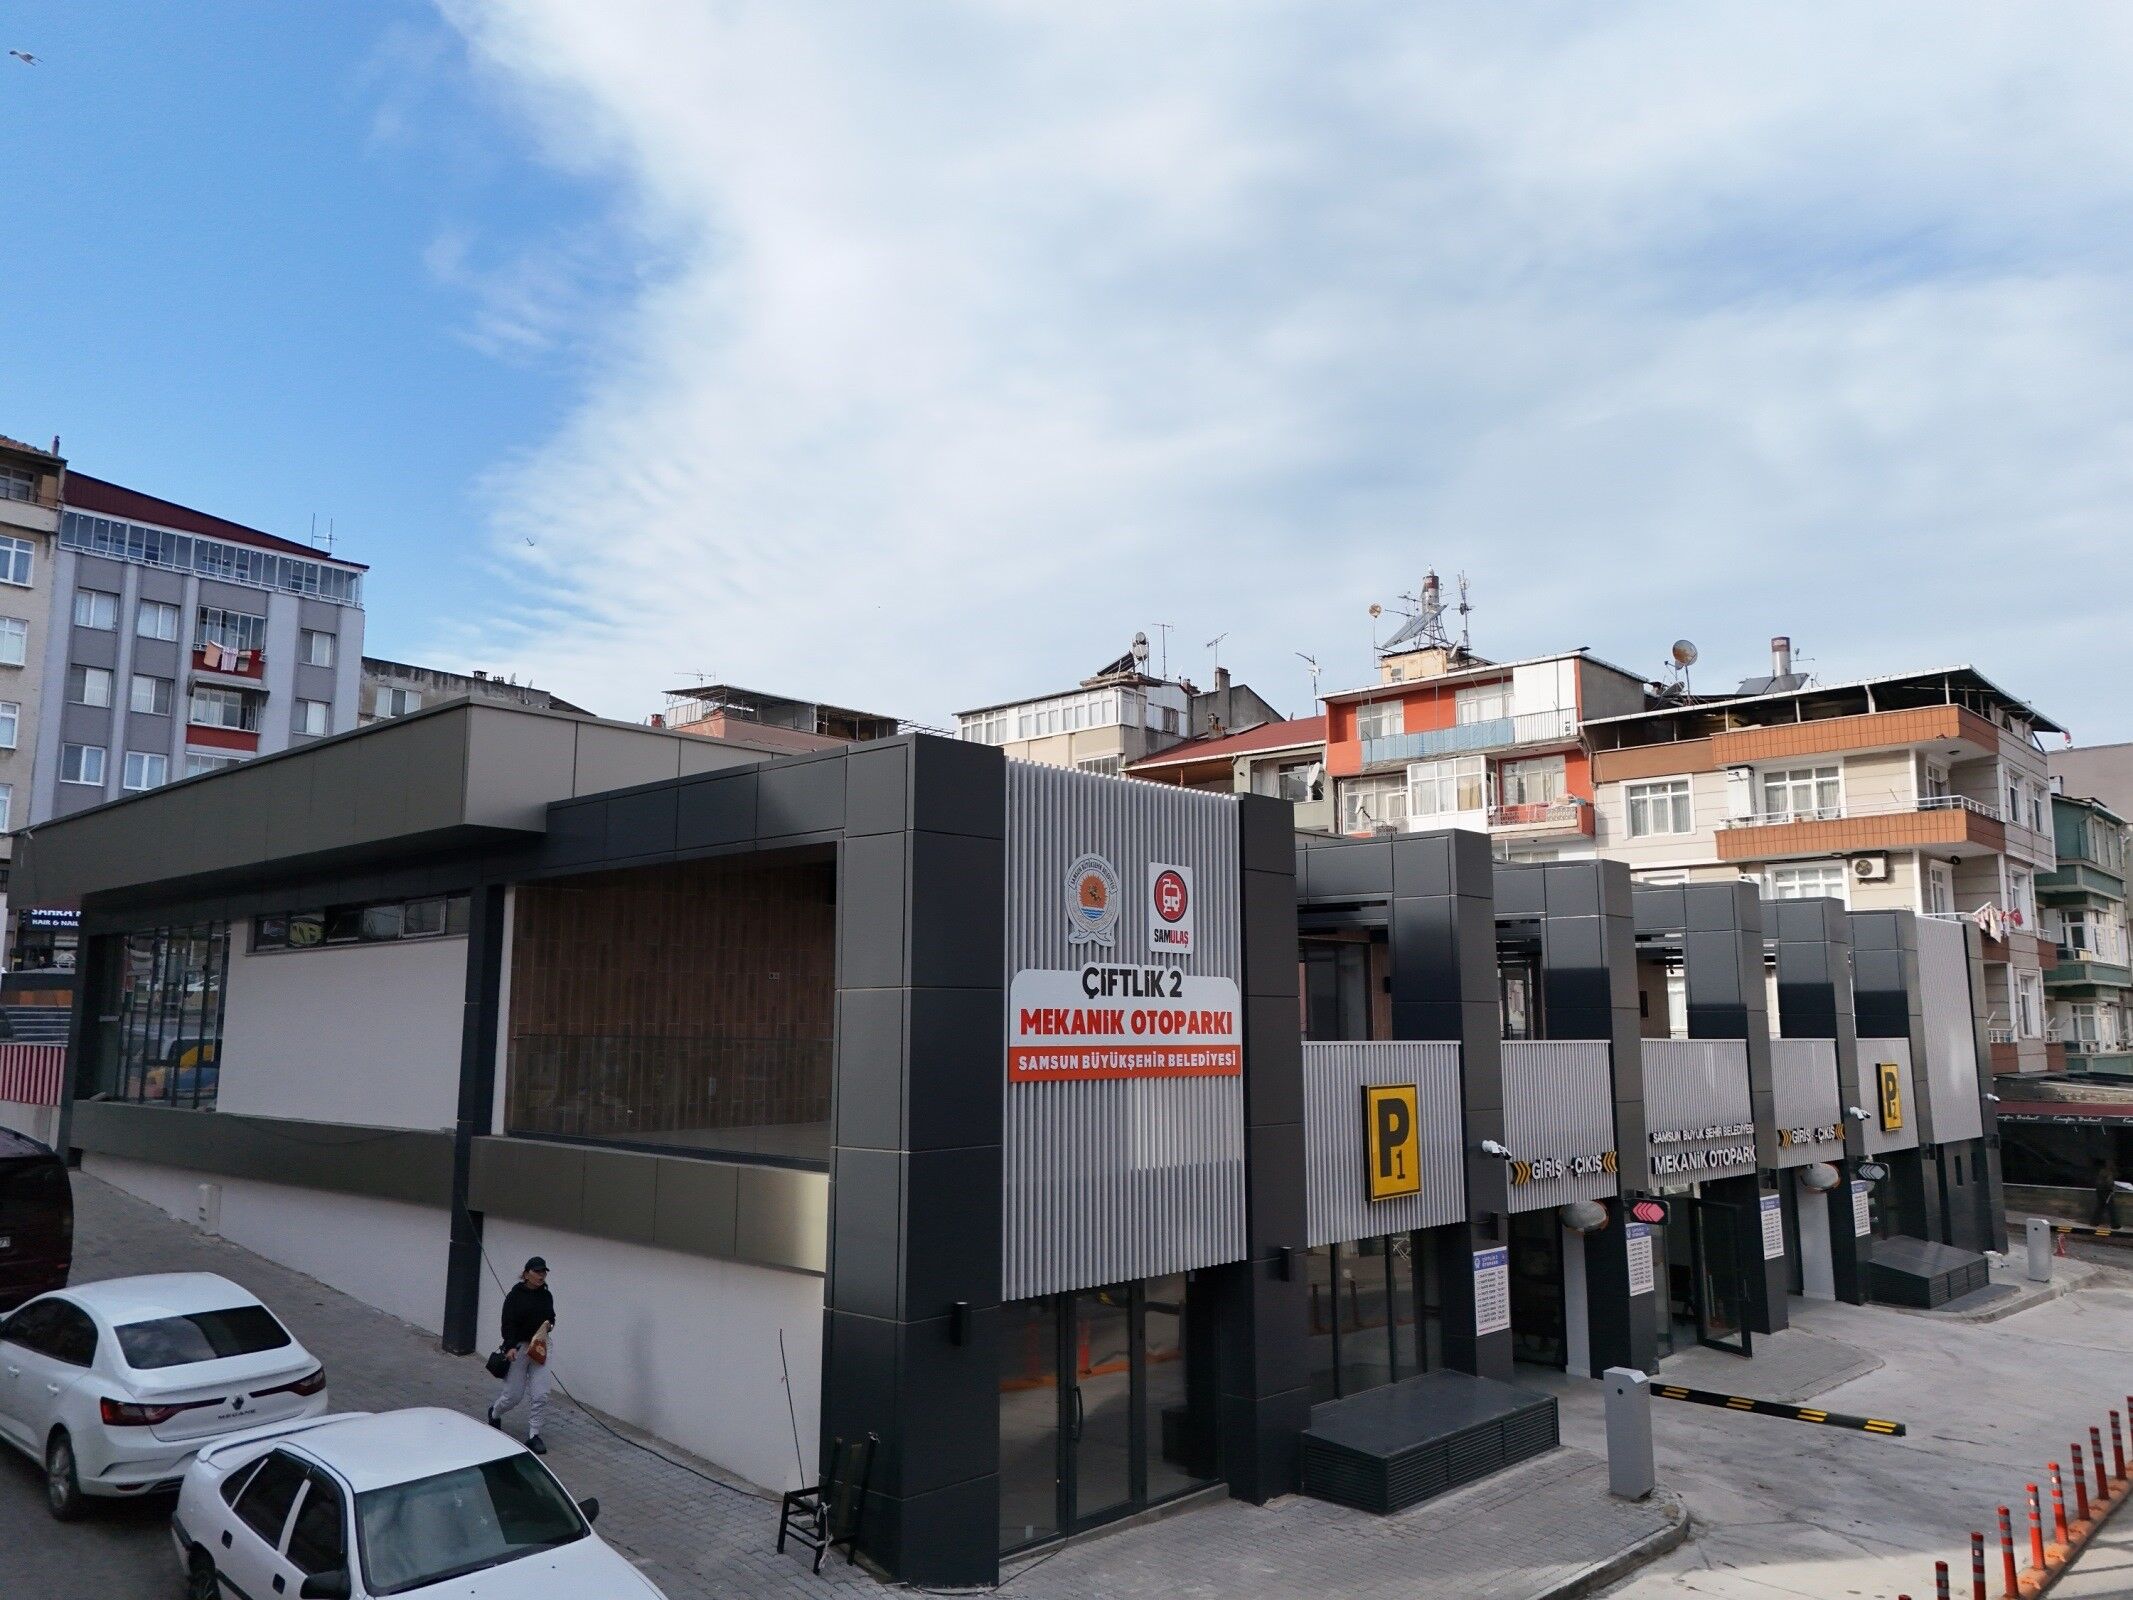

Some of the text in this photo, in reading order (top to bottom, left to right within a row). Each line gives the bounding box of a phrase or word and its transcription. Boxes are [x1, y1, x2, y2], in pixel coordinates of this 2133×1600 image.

[1154, 928, 1189, 949] SAMULAŞ
[1082, 966, 1183, 999] ÇİFTLİK 2
[1020, 1008, 1233, 1035] MEKANİK OTOPARKI
[1018, 1050, 1237, 1071] SAMSUN BÜYÜKŞEHİR BELEDİYESİ
[1652, 1130, 1681, 1144] SAMSUN
[1654, 1144, 1757, 1175] MEKANİK OTOPARK
